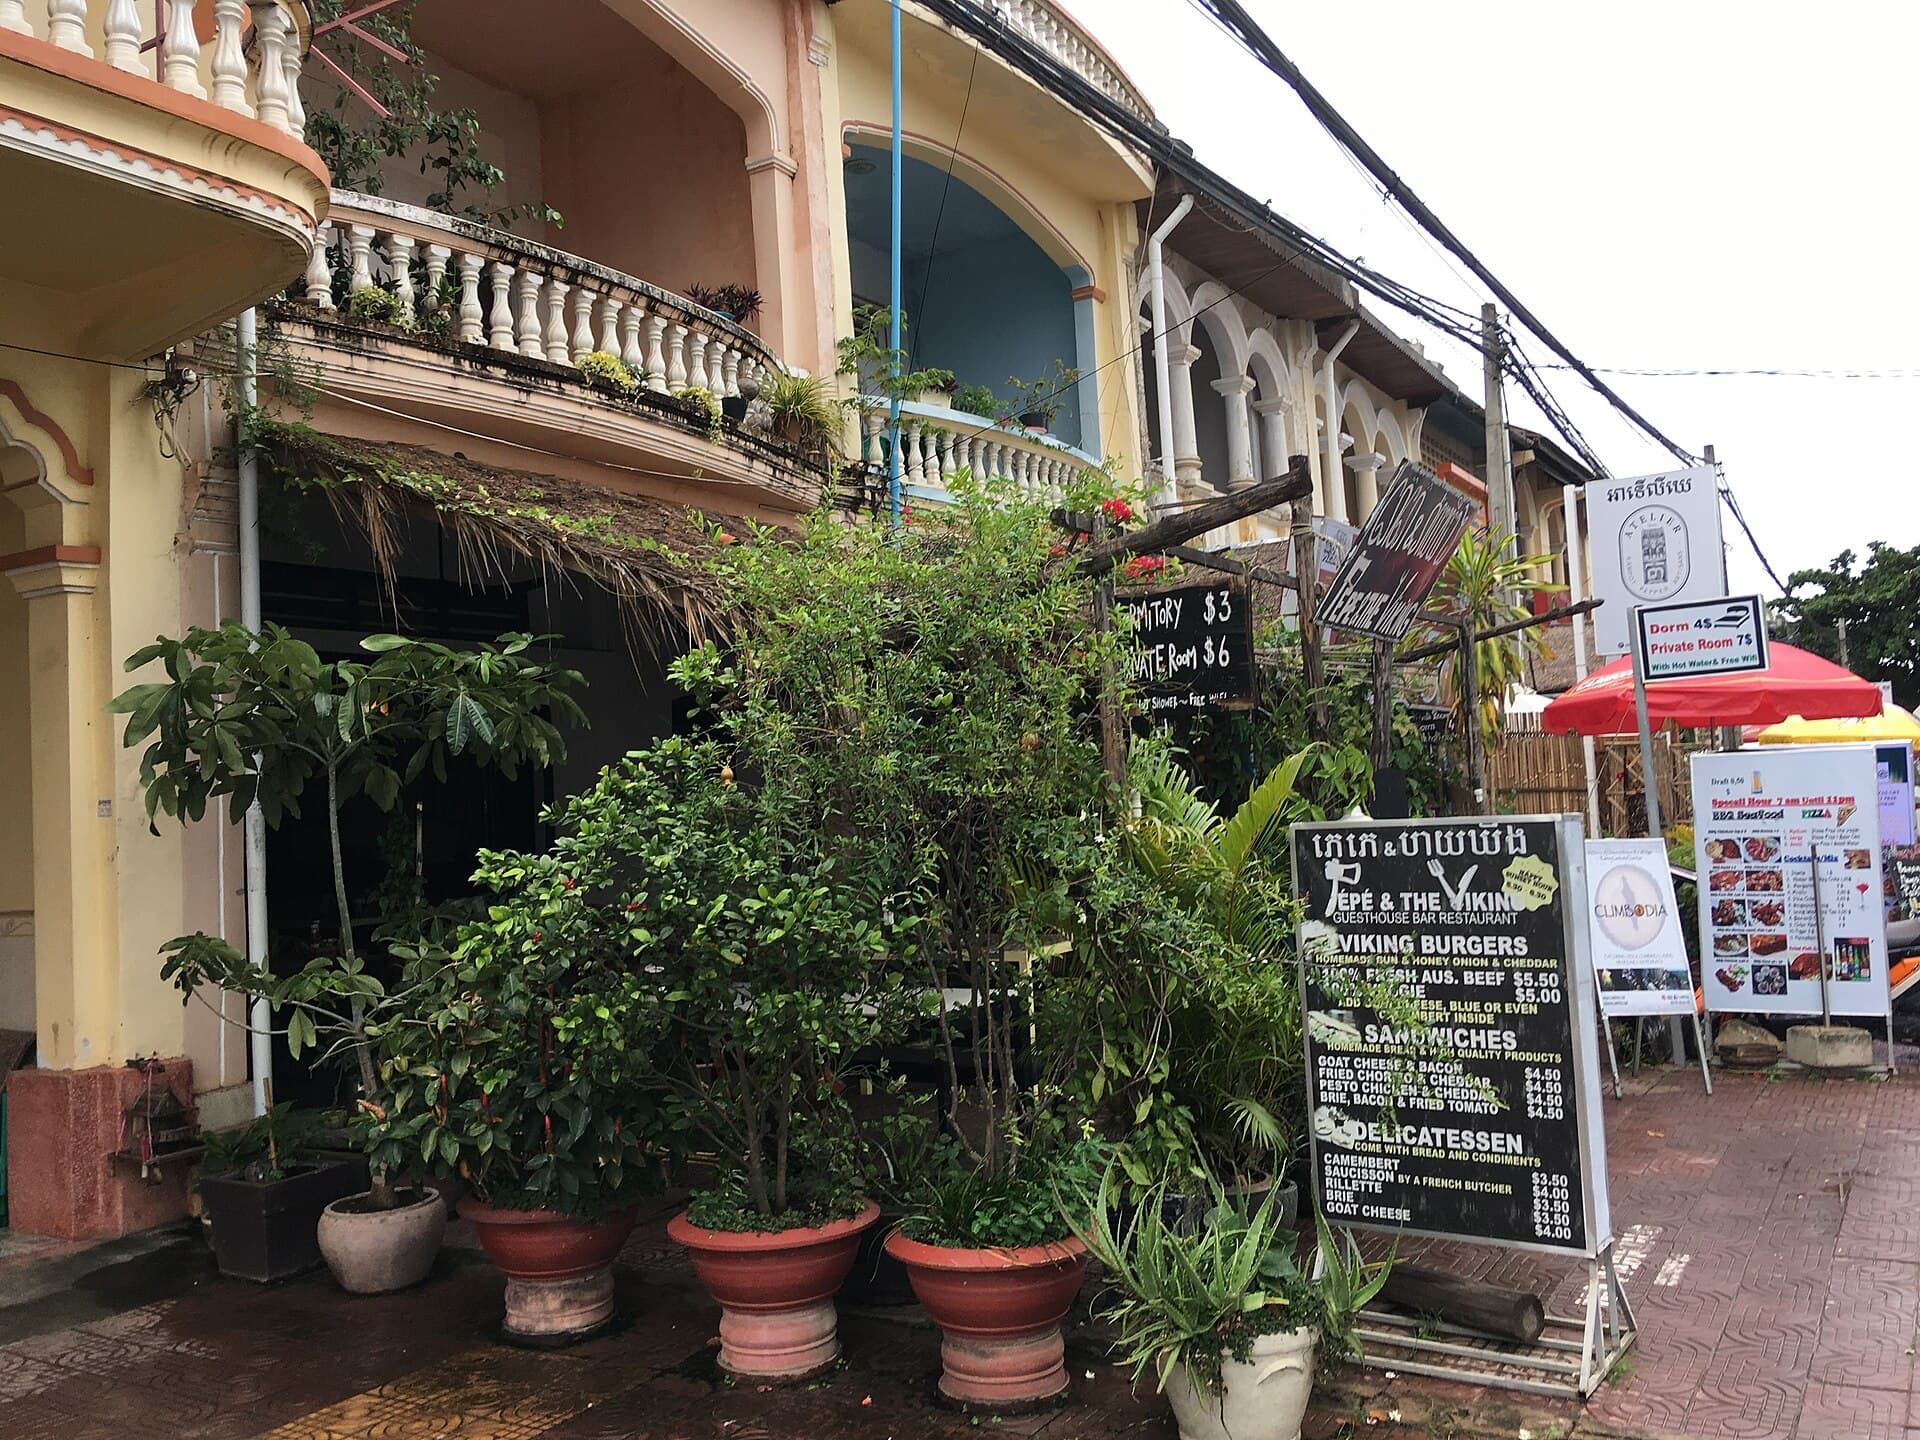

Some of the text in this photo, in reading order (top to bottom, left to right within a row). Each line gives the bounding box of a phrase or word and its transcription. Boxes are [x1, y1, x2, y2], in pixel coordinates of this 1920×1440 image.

[1625, 512, 1682, 539] ATELIER
[1650, 618, 1713, 634] Dorm 4$
[1651, 633, 1753, 655] Private Room 7$
[1651, 662, 1670, 671] With
[1672, 660, 1686, 669] Hot
[1721, 656, 1739, 665] Free
[1802, 807, 1832, 819] PIZZA
[1383, 841, 1397, 857] &
[1380, 892, 1395, 912] &
[1400, 892, 1440, 911] THE
[1594, 903, 1669, 918] CLIMBODIA
[1333, 911, 1518, 925] GUESTHOUSE BAR RESTAURANT
[1338, 934, 1528, 956] VIKING BURGERS
[1453, 957, 1488, 967] ONION
[1492, 958, 1499, 967] &
[1503, 958, 1557, 968] CHEDDAR
[1422, 969, 1458, 984] AUS.
[1464, 971, 1505, 985] BEEF
[1513, 971, 1559, 987] $5.50
[1515, 987, 1561, 1004] $5.00
[1450, 1000, 1480, 1012] BLUE
[1484, 1002, 1501, 1013] OR
[1504, 1003, 1538, 1015] EVEN
[1455, 1012, 1495, 1025] INSIDE
[1327, 1042, 1381, 1054] HOMEMADE
[1458, 1049, 1501, 1061] QUALITY
[1505, 1051, 1562, 1064] PRODUCTS
[1318, 1056, 1350, 1067] GOAT
[1353, 1057, 1402, 1071] CHEESE
[1419, 1061, 1463, 1074] BACON
[1524, 1067, 1561, 1081] $4.50
[1319, 1068, 1354, 1080] FRIED
[1430, 1074, 1491, 1088] CHEDDAR
[1525, 1080, 1562, 1094] $4.50
[1319, 1080, 1359, 1092] PESTO
[1526, 1093, 1563, 1107] $4.50
[1320, 1091, 1564, 1120] BRIE, BACON & FRIED TOMATO $4.50
[1356, 1121, 1523, 1155] DELICATESSEN
[1354, 1141, 1541, 1168] COME WITH BREAD AND CONDIMENTS
[1323, 1153, 1568, 1187] CAMEMBERT $3.50
[1324, 1165, 1569, 1200] SAUCISSON BY A FRENCH BUTCHER $4.00
[1325, 1177, 1570, 1214] RILLETTE $3.50
[1326, 1189, 1570, 1227] BRIE $3.50
[1326, 1201, 1572, 1240] GOAT CHEESE $4.00
